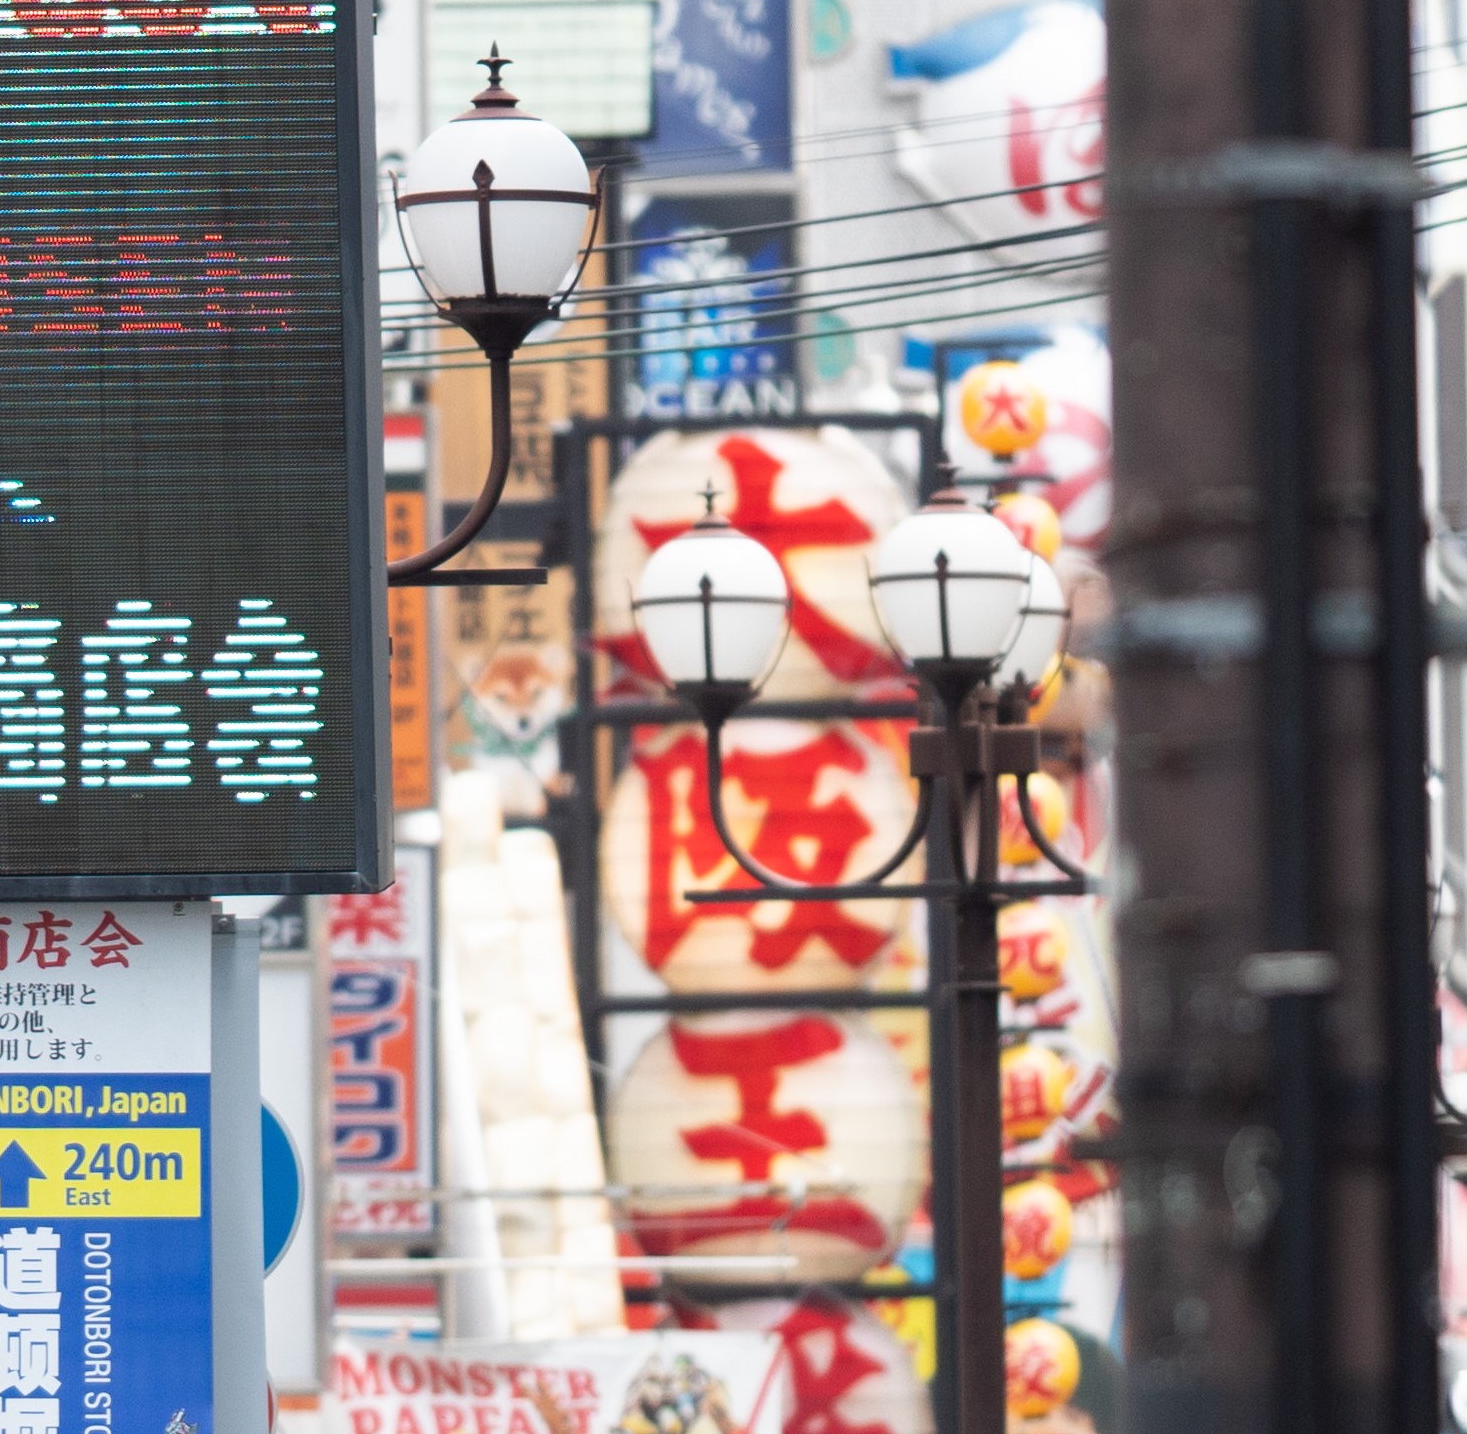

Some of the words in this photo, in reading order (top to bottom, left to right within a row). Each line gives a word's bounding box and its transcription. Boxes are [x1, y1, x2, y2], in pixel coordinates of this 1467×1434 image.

[98, 1085, 188, 1122] Japan
[63, 1140, 184, 1182] 240m
[65, 1186, 112, 1208] East
[82, 1231, 112, 1384] DOTONBORI
[337, 1354, 599, 1408] MONSTER
